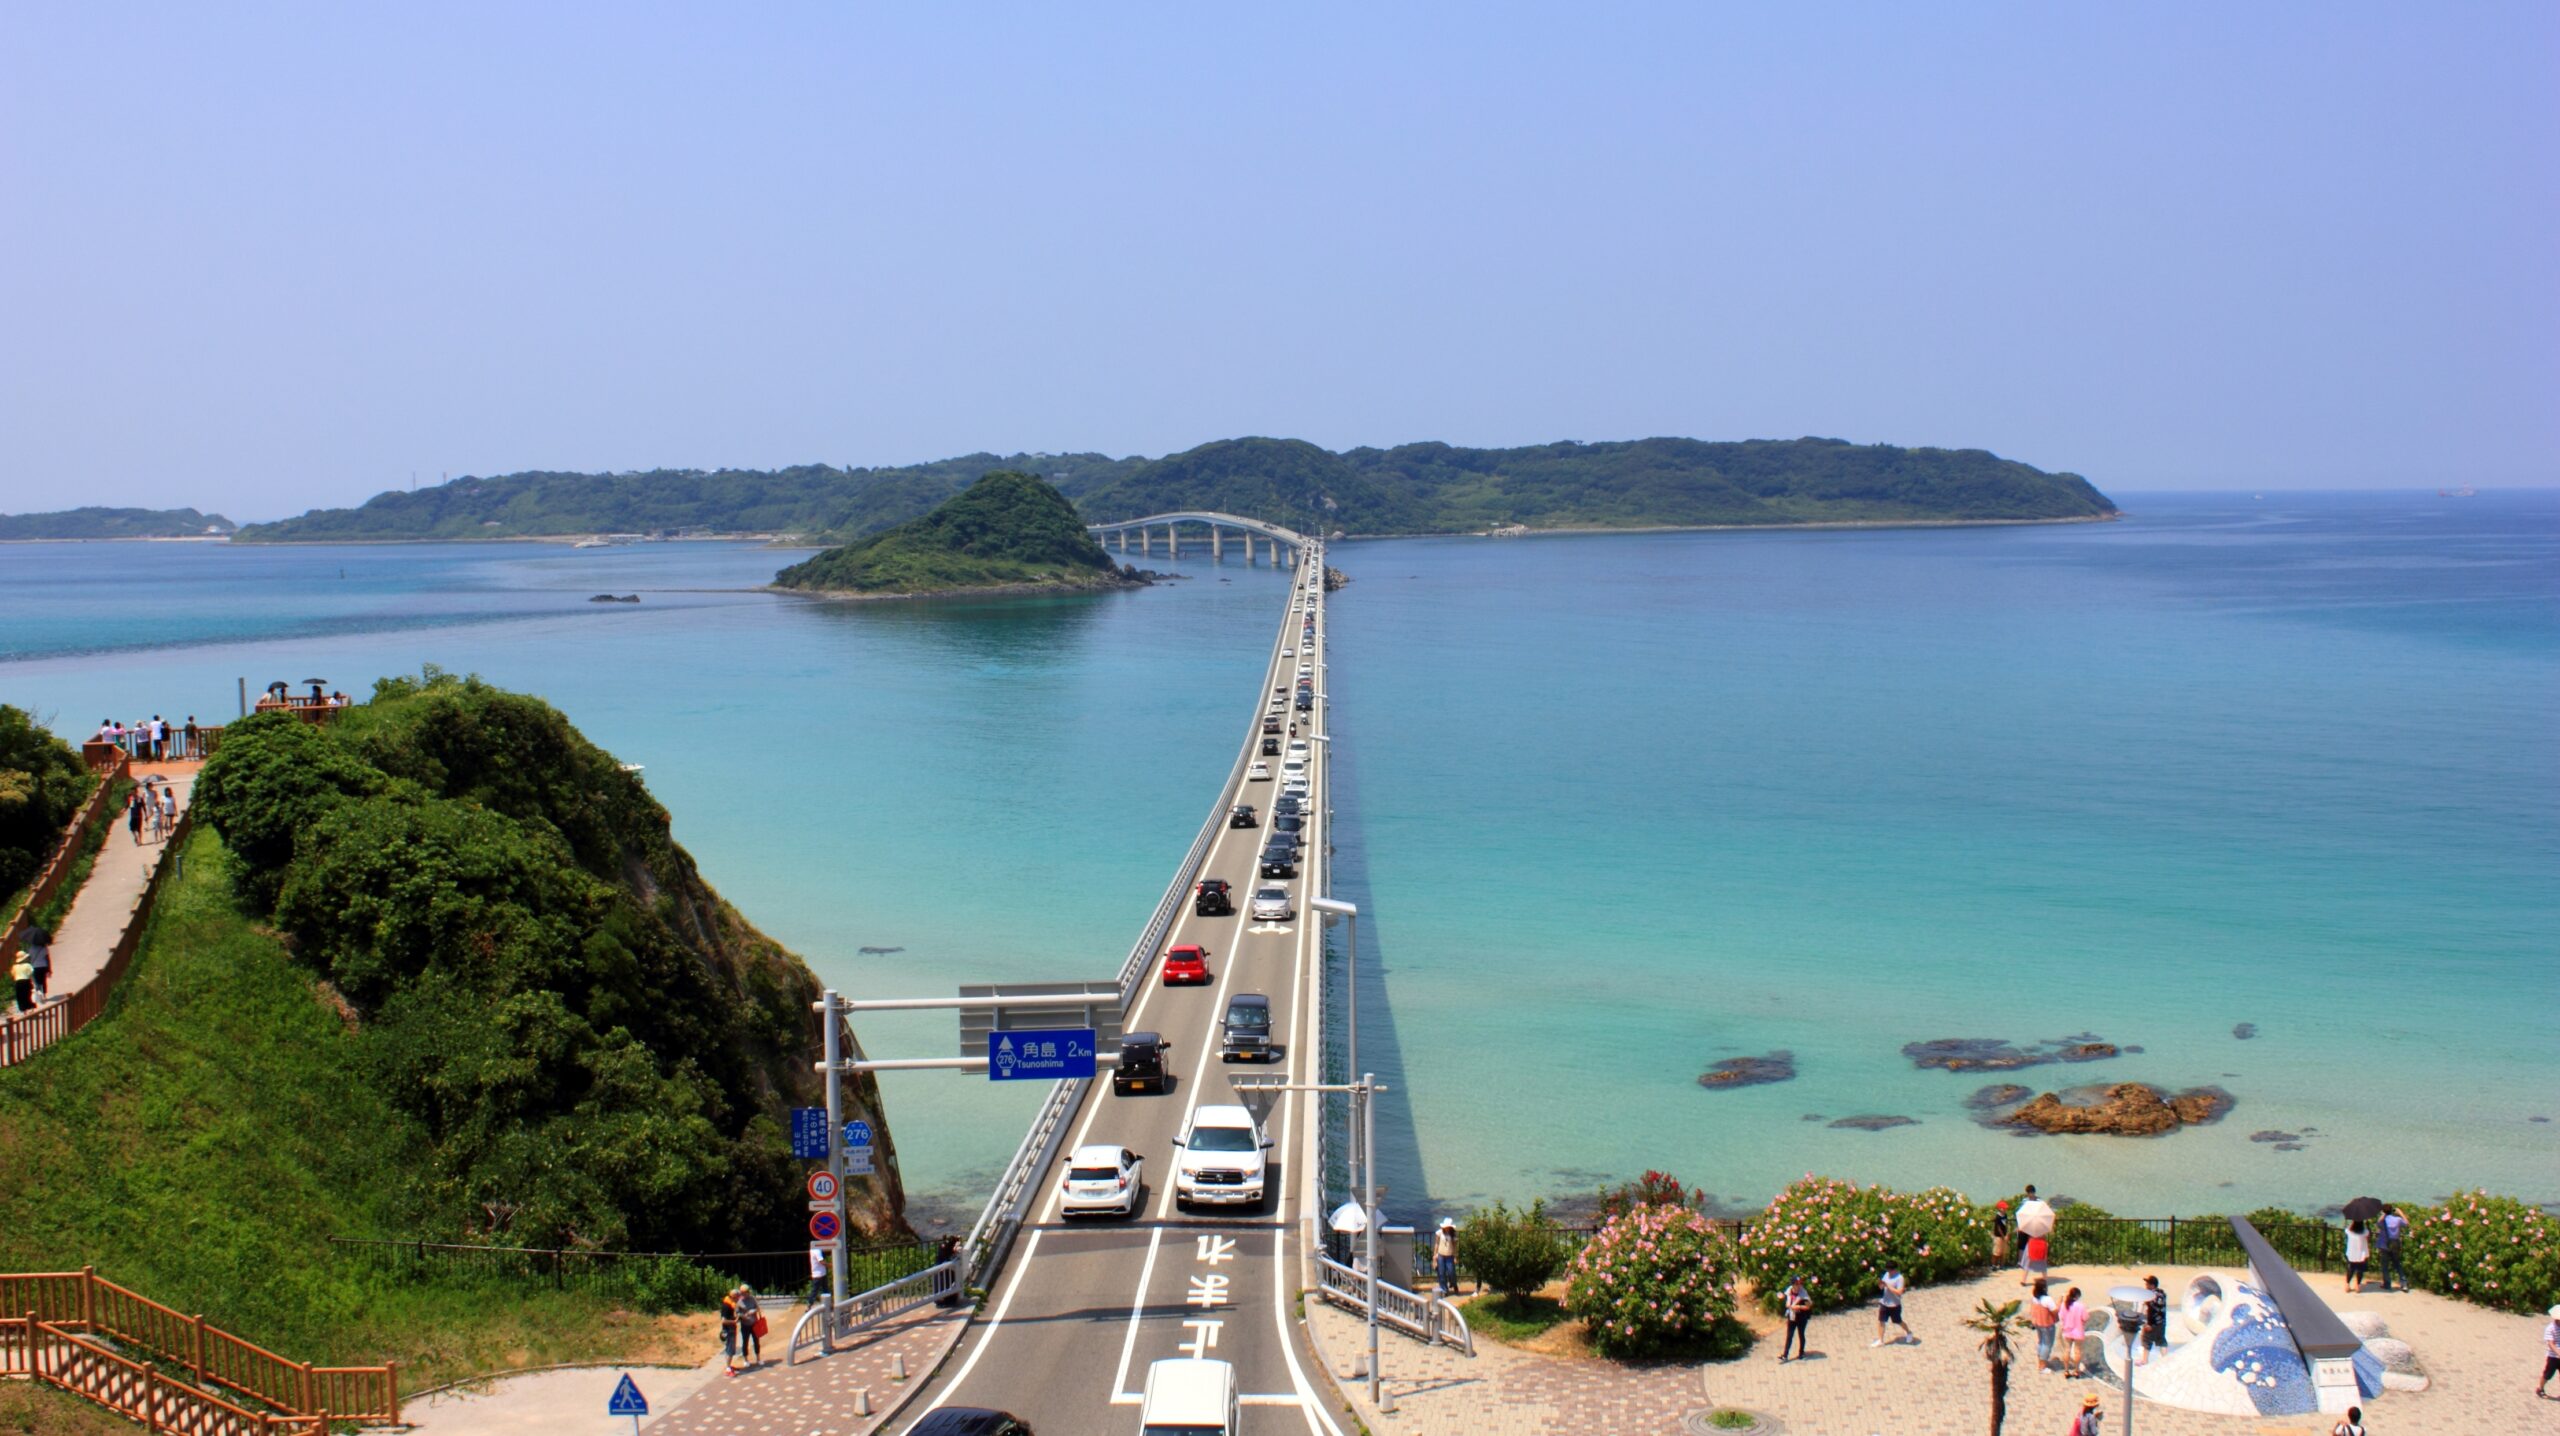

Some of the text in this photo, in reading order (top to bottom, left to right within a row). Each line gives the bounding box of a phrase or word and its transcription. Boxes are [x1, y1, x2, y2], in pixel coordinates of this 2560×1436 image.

[1022, 1042, 1057, 1058] 角島
[999, 1055, 1013, 1064] 276
[1017, 1059, 1064, 1069] Tsunoshima
[846, 1128, 868, 1140] 276
[816, 1180, 833, 1194] 40
